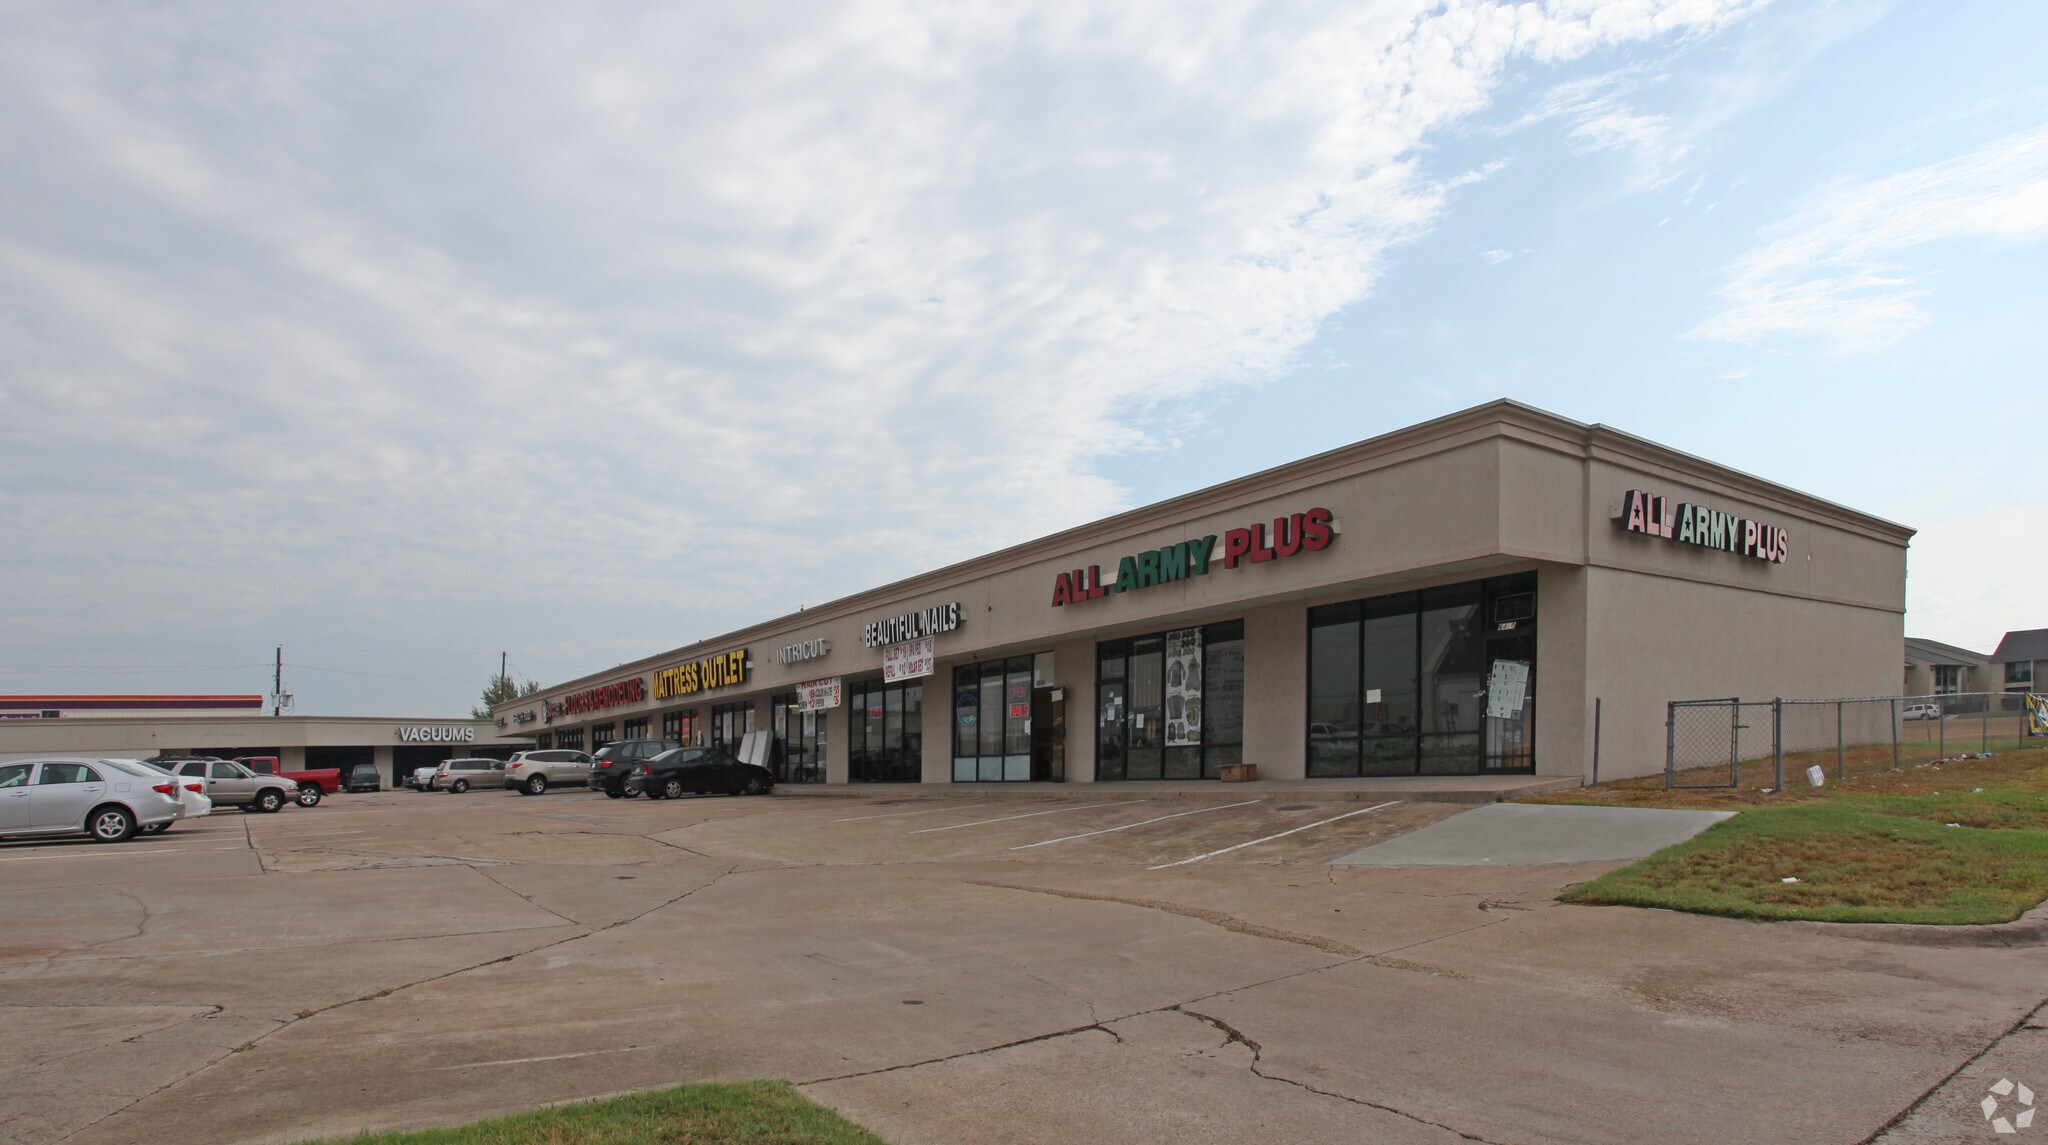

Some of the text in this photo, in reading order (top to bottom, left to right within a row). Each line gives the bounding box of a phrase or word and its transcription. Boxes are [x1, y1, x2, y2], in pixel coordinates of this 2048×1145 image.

[1624, 490, 1788, 564] ALL ARMY PLUS
[1052, 507, 1335, 607] ALL ARMY PLUS
[865, 602, 958, 648] BEAUTIFUL NAILS
[652, 649, 746, 699] MATTRESS OUTLET
[776, 637, 826, 665] INTRICUT
[400, 726, 475, 742] VACUUMS
